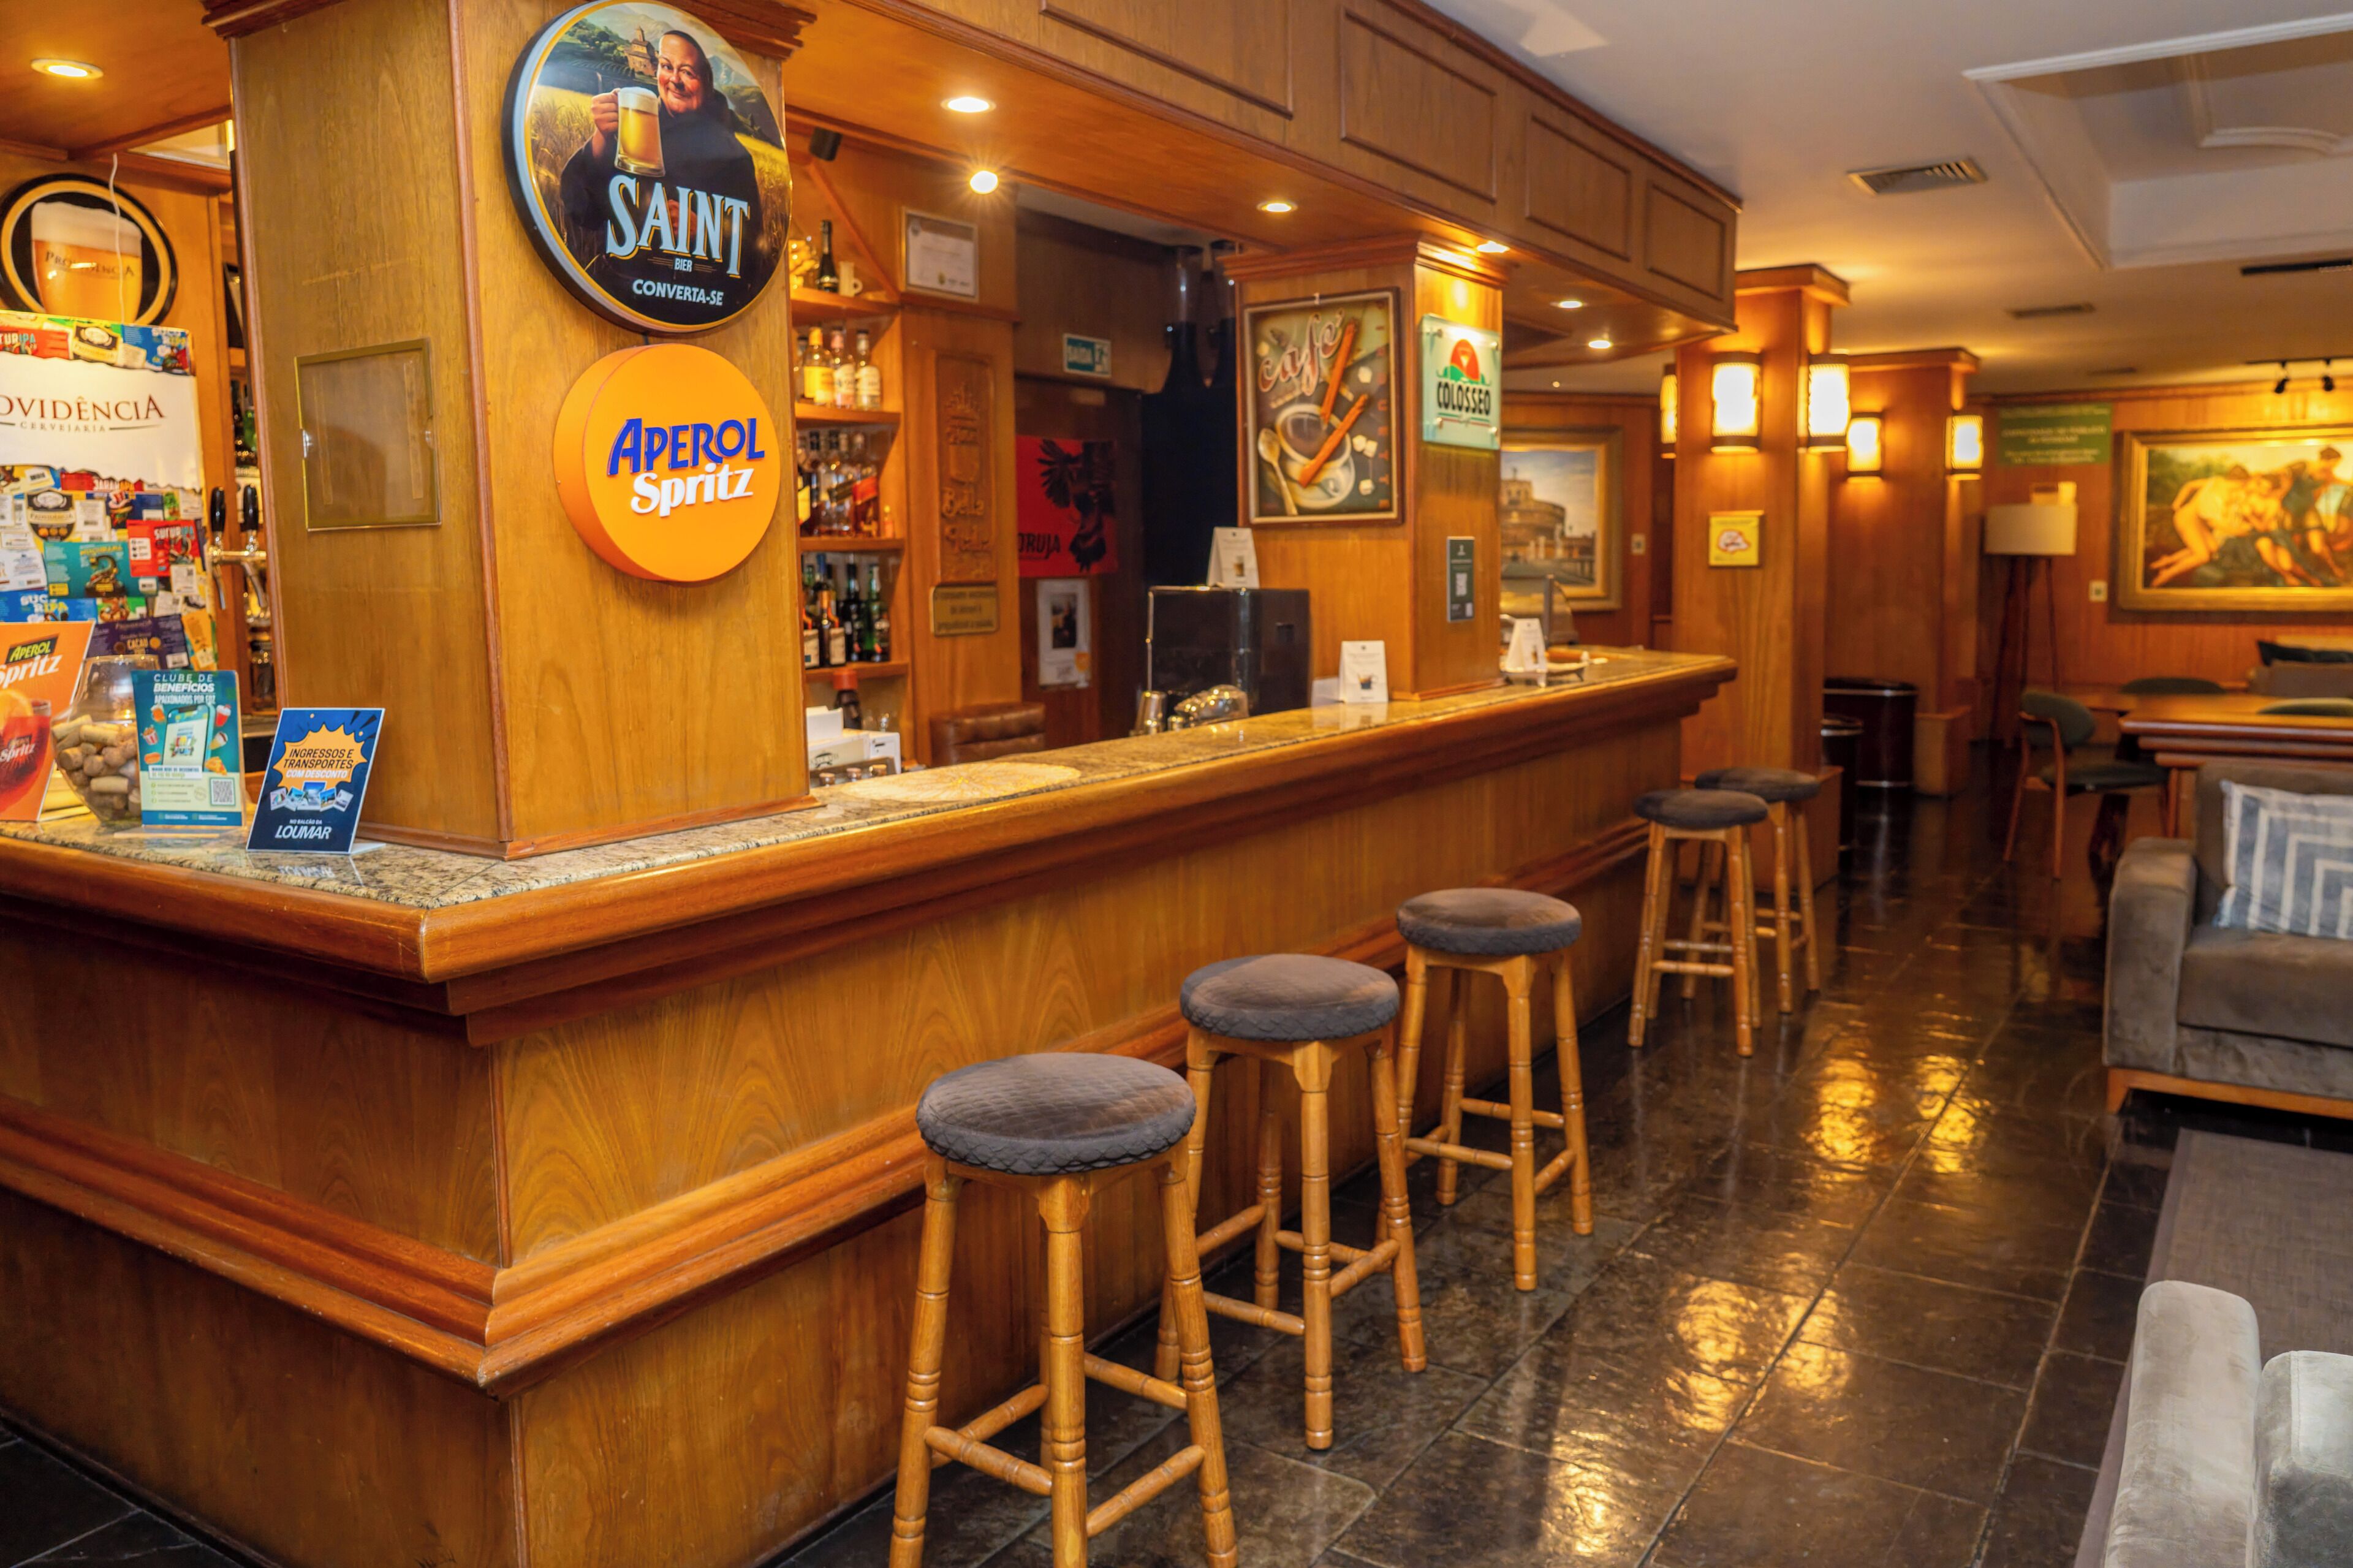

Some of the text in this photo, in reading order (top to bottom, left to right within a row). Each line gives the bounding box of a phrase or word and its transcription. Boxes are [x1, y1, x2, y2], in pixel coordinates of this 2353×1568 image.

[606, 174, 750, 278] SAINT
[674, 258, 692, 272] BIER
[632, 279, 724, 306] CONVERTA-SE
[1437, 381, 1491, 415] COLOSSEO
[607, 417, 765, 476] APEROL
[631, 462, 754, 518] Spritz
[10, 641, 51, 662] APEROL
[154, 673, 213, 683] CLUBE DE
[153, 680, 215, 693] BENEFÍCIOS
[289, 748, 354, 759] INGRESSOS E
[283, 759, 354, 769] TRANSPORTES
[286, 770, 305, 778] COM
[275, 825, 332, 839] LOUMAR
